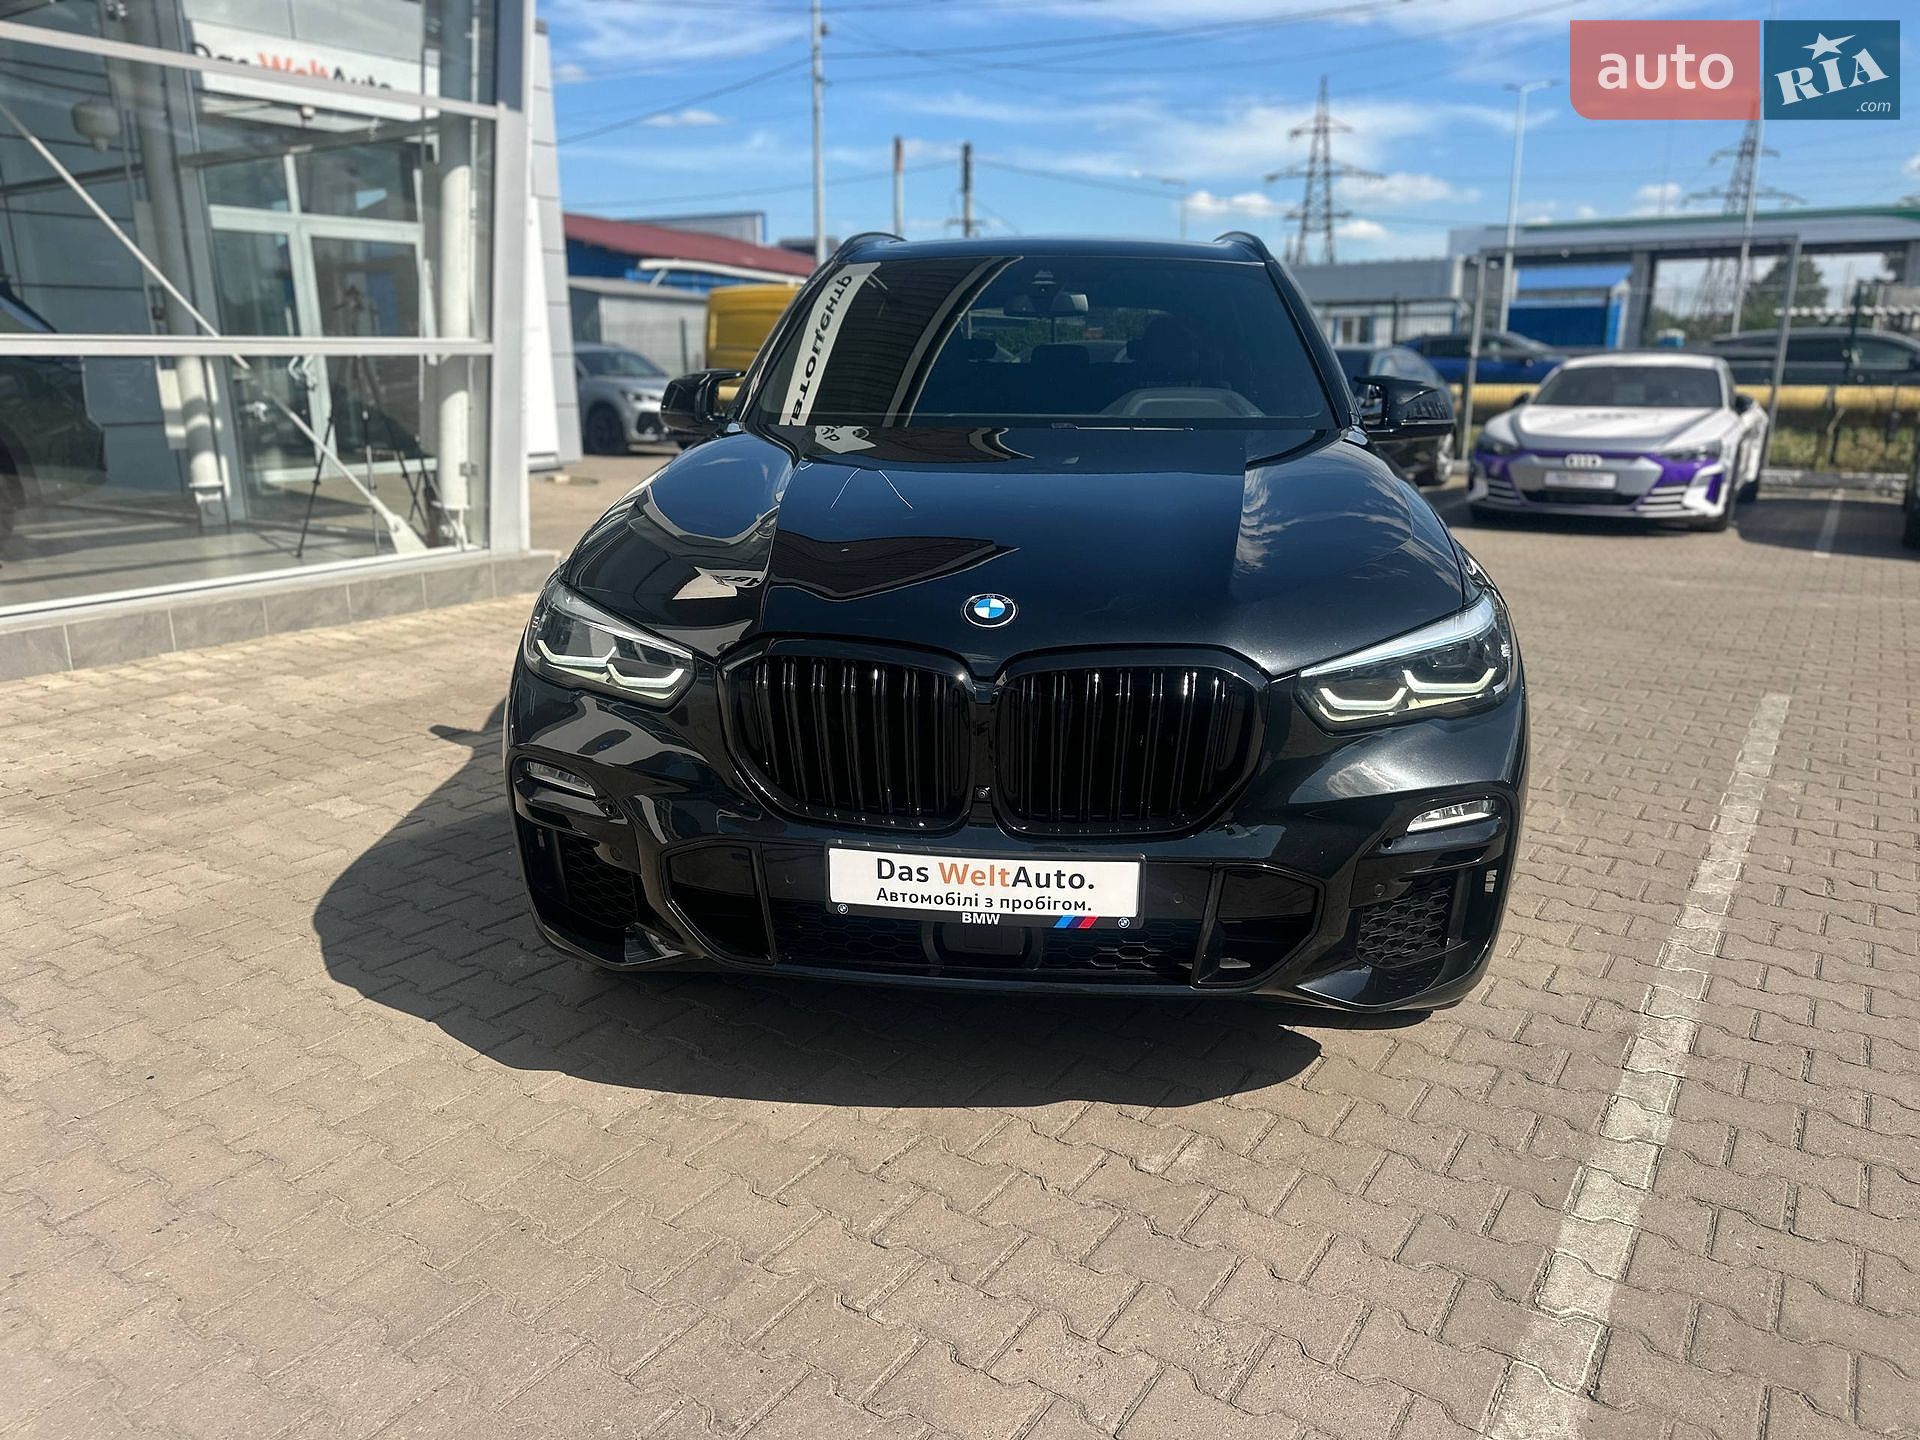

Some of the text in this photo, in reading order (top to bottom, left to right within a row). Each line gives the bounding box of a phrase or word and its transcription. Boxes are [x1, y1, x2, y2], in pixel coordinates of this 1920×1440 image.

[876, 858, 1095, 889] Das WeltAuto.
[876, 887, 1092, 912] Автомобілі з пробігом.
[961, 912, 1000, 925] BMW
